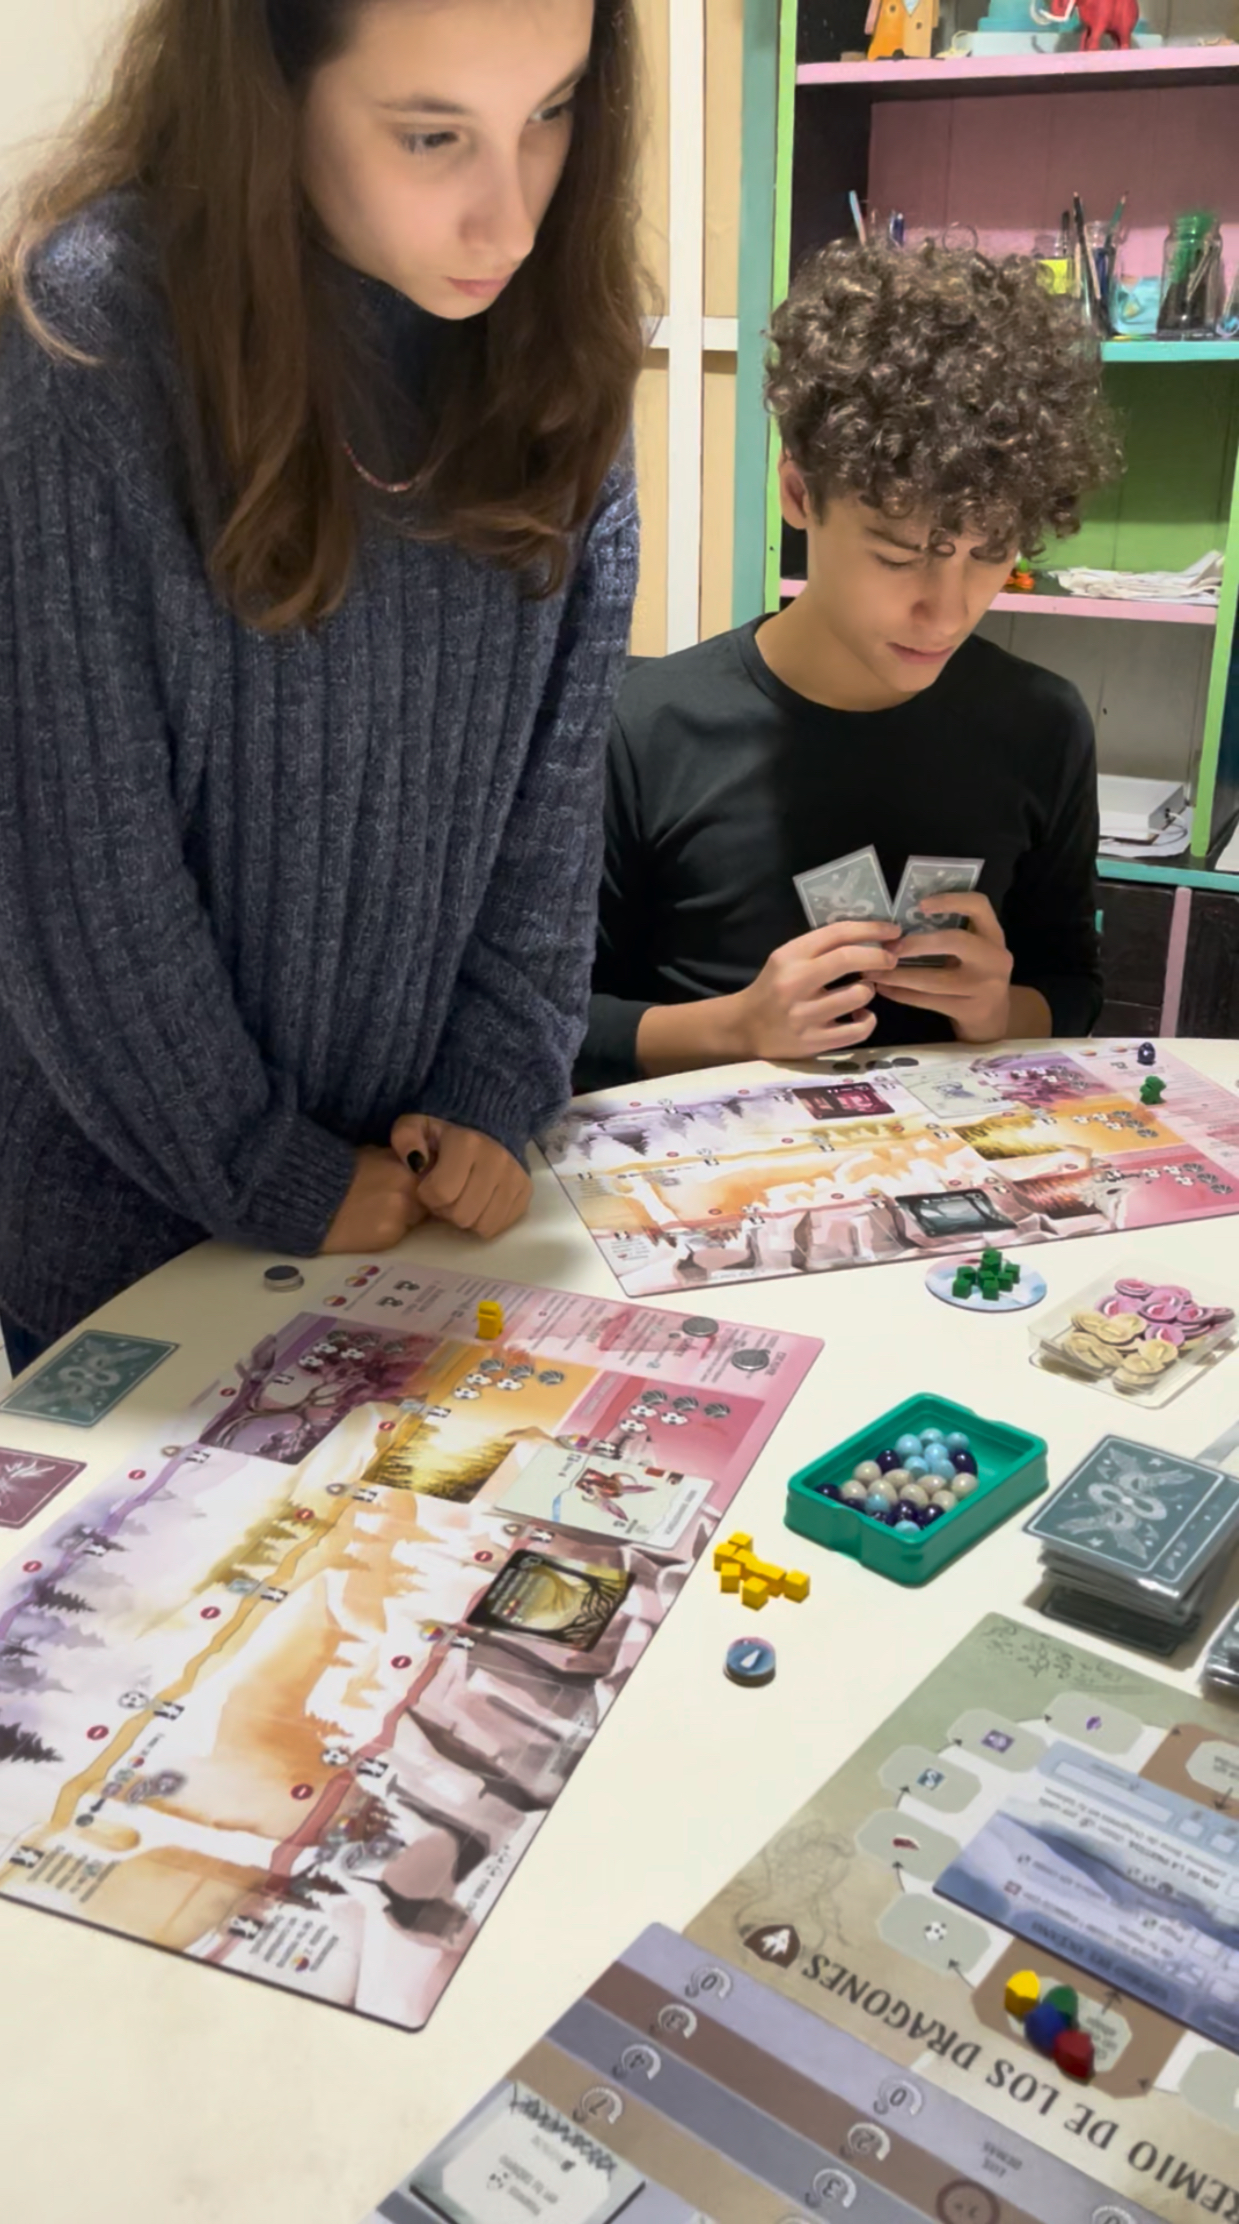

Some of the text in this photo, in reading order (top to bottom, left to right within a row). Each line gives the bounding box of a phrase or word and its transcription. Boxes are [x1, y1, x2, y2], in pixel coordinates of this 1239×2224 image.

[801, 1954, 991, 2067] DRAGONES
[986, 2055, 1064, 2117] LOS
[1063, 2102, 1121, 2151] DE
